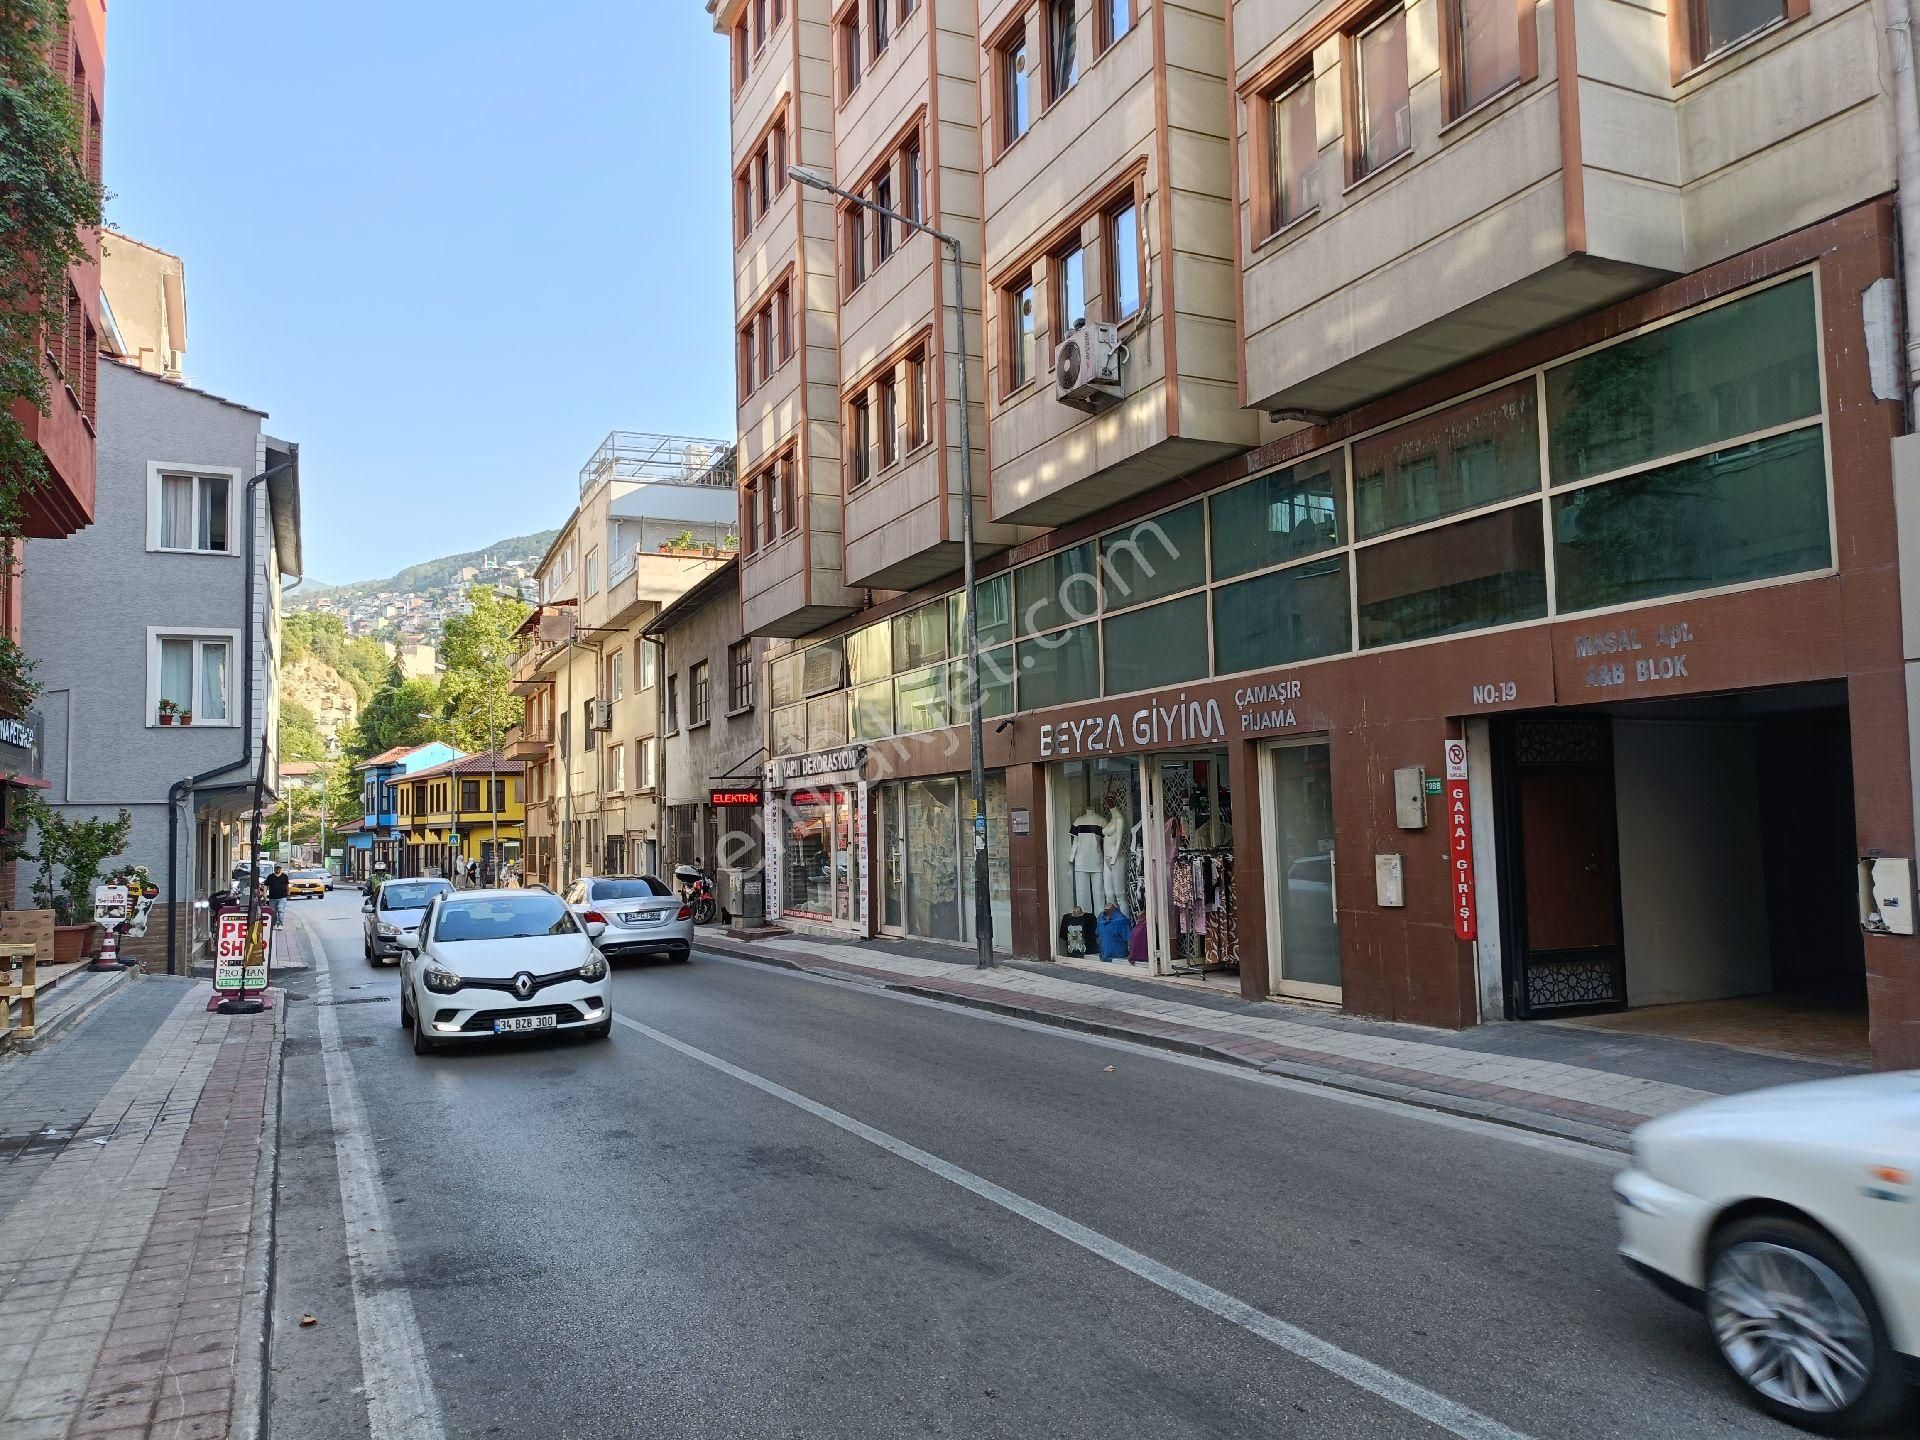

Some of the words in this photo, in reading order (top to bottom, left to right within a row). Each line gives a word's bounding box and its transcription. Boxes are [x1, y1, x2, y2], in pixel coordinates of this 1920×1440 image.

[1575, 628, 1642, 657] MASAL
[1636, 654, 1689, 682] BLOK
[1234, 680, 1301, 711] ÇAMAŞIR
[1472, 681, 1517, 705] NO:19
[1132, 693, 1226, 746] GİYİM
[1241, 708, 1297, 732] PİJAMA
[802, 750, 856, 774] DEKORASYON
[713, 793, 759, 804] ELEKTRİK
[1452, 788, 1466, 851] GARAJ
[1456, 859, 1470, 932] GİRİŞİ
[219, 941, 268, 957] SHP
[500, 1020, 512, 1030] 34
[536, 1016, 553, 1027] 300
